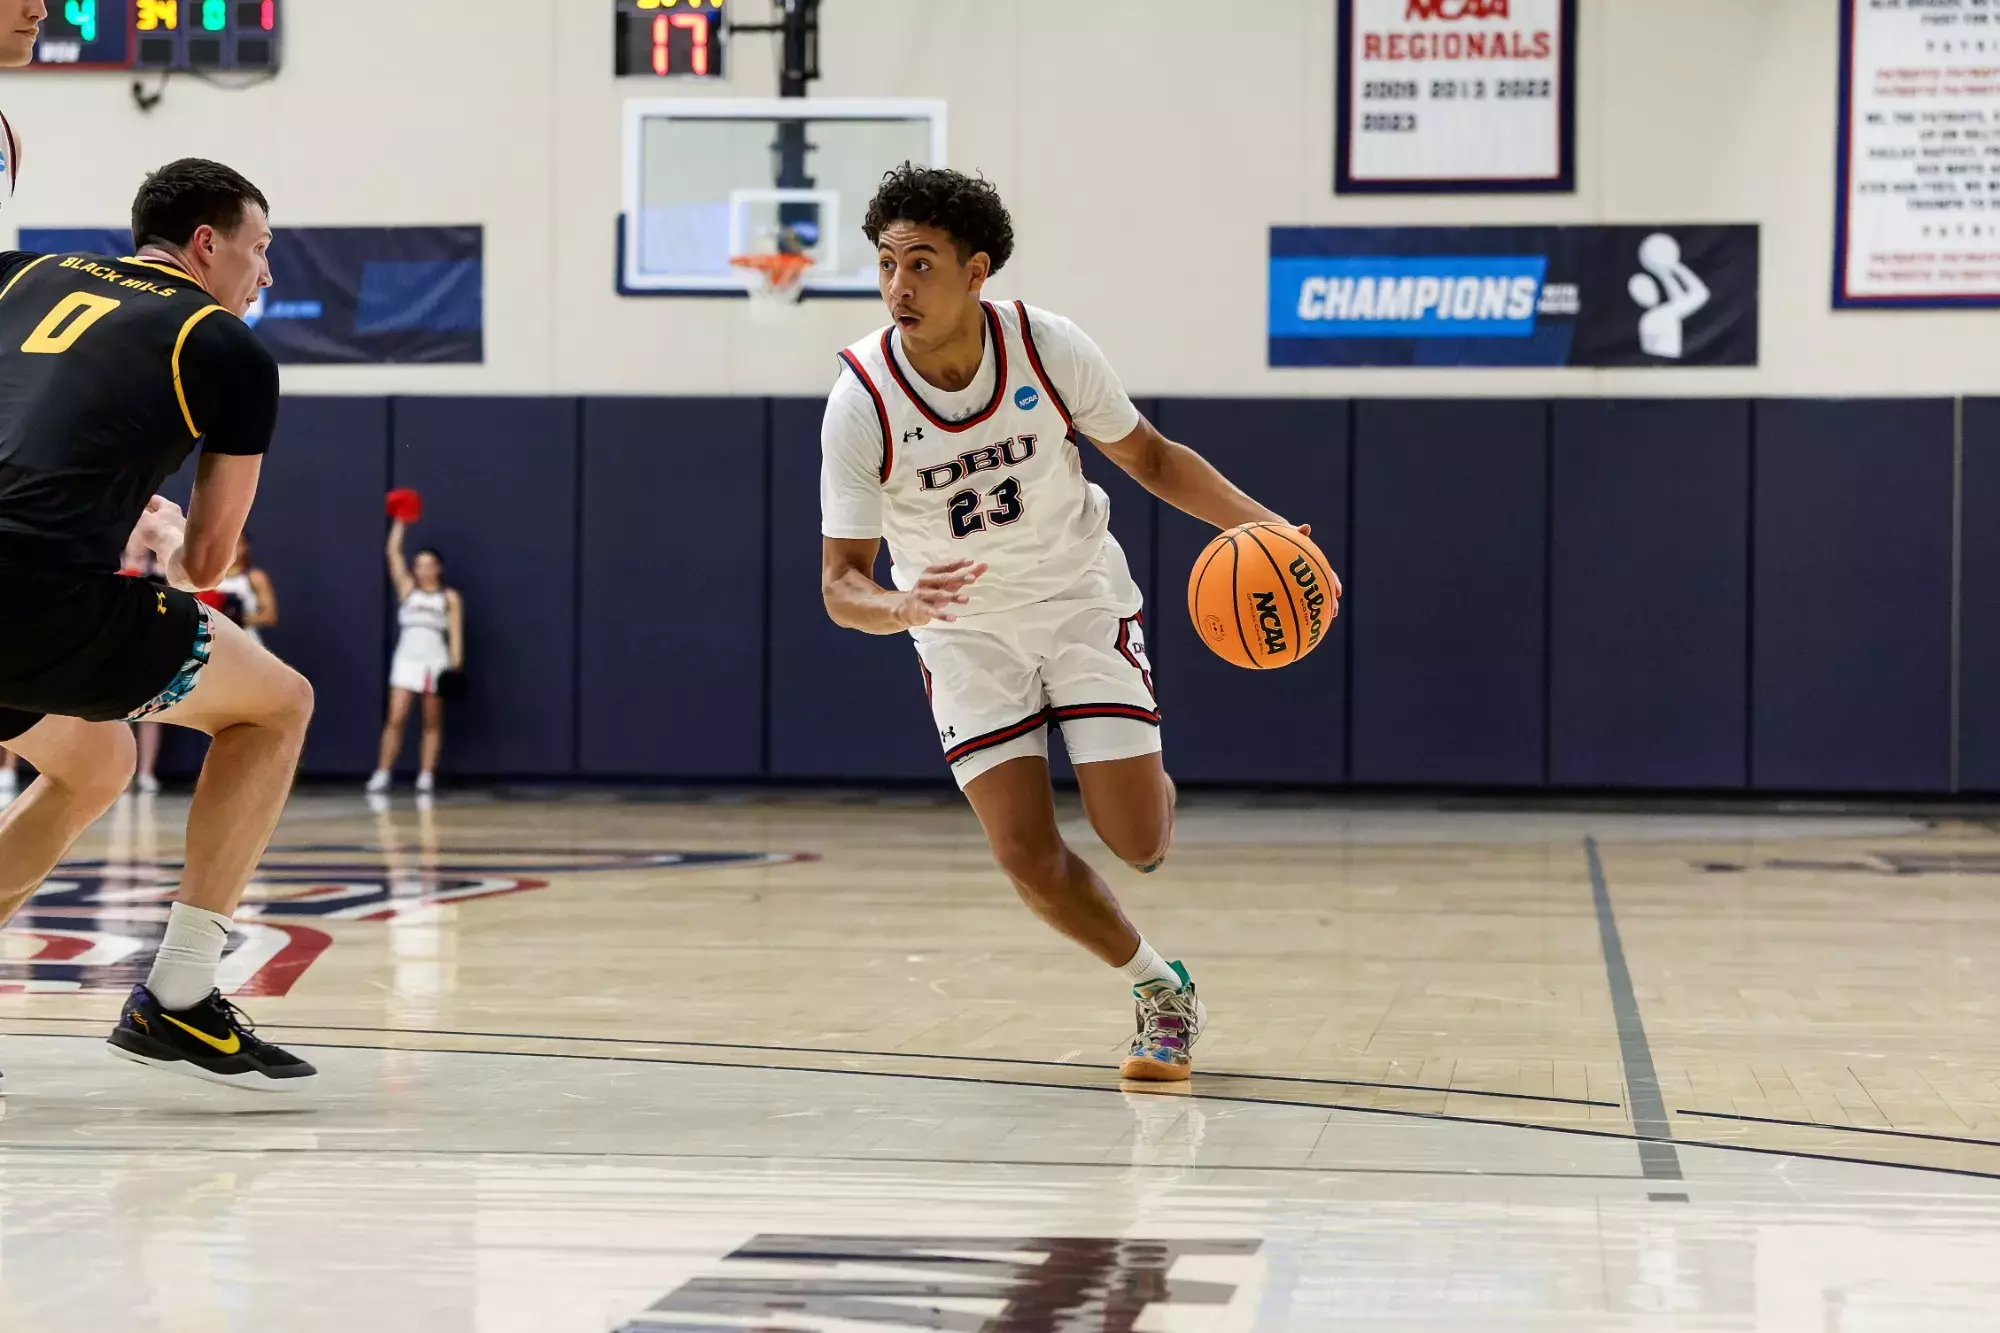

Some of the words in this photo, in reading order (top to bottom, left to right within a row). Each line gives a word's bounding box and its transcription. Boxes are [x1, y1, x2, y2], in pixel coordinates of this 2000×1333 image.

[652, 13, 708, 76] 17
[1363, 32, 1551, 60] REGIONALS
[58, 256, 123, 283] BLACK
[119, 278, 177, 297] HILLS
[1297, 277, 1538, 321] CHAMPIONS
[21, 291, 121, 354] 0
[1019, 394, 1038, 408] NCAA
[916, 434, 1038, 491] DBU
[946, 475, 1025, 539] 23
[1252, 591, 1287, 655] NCAA
[1289, 554, 1325, 649] Wilson
